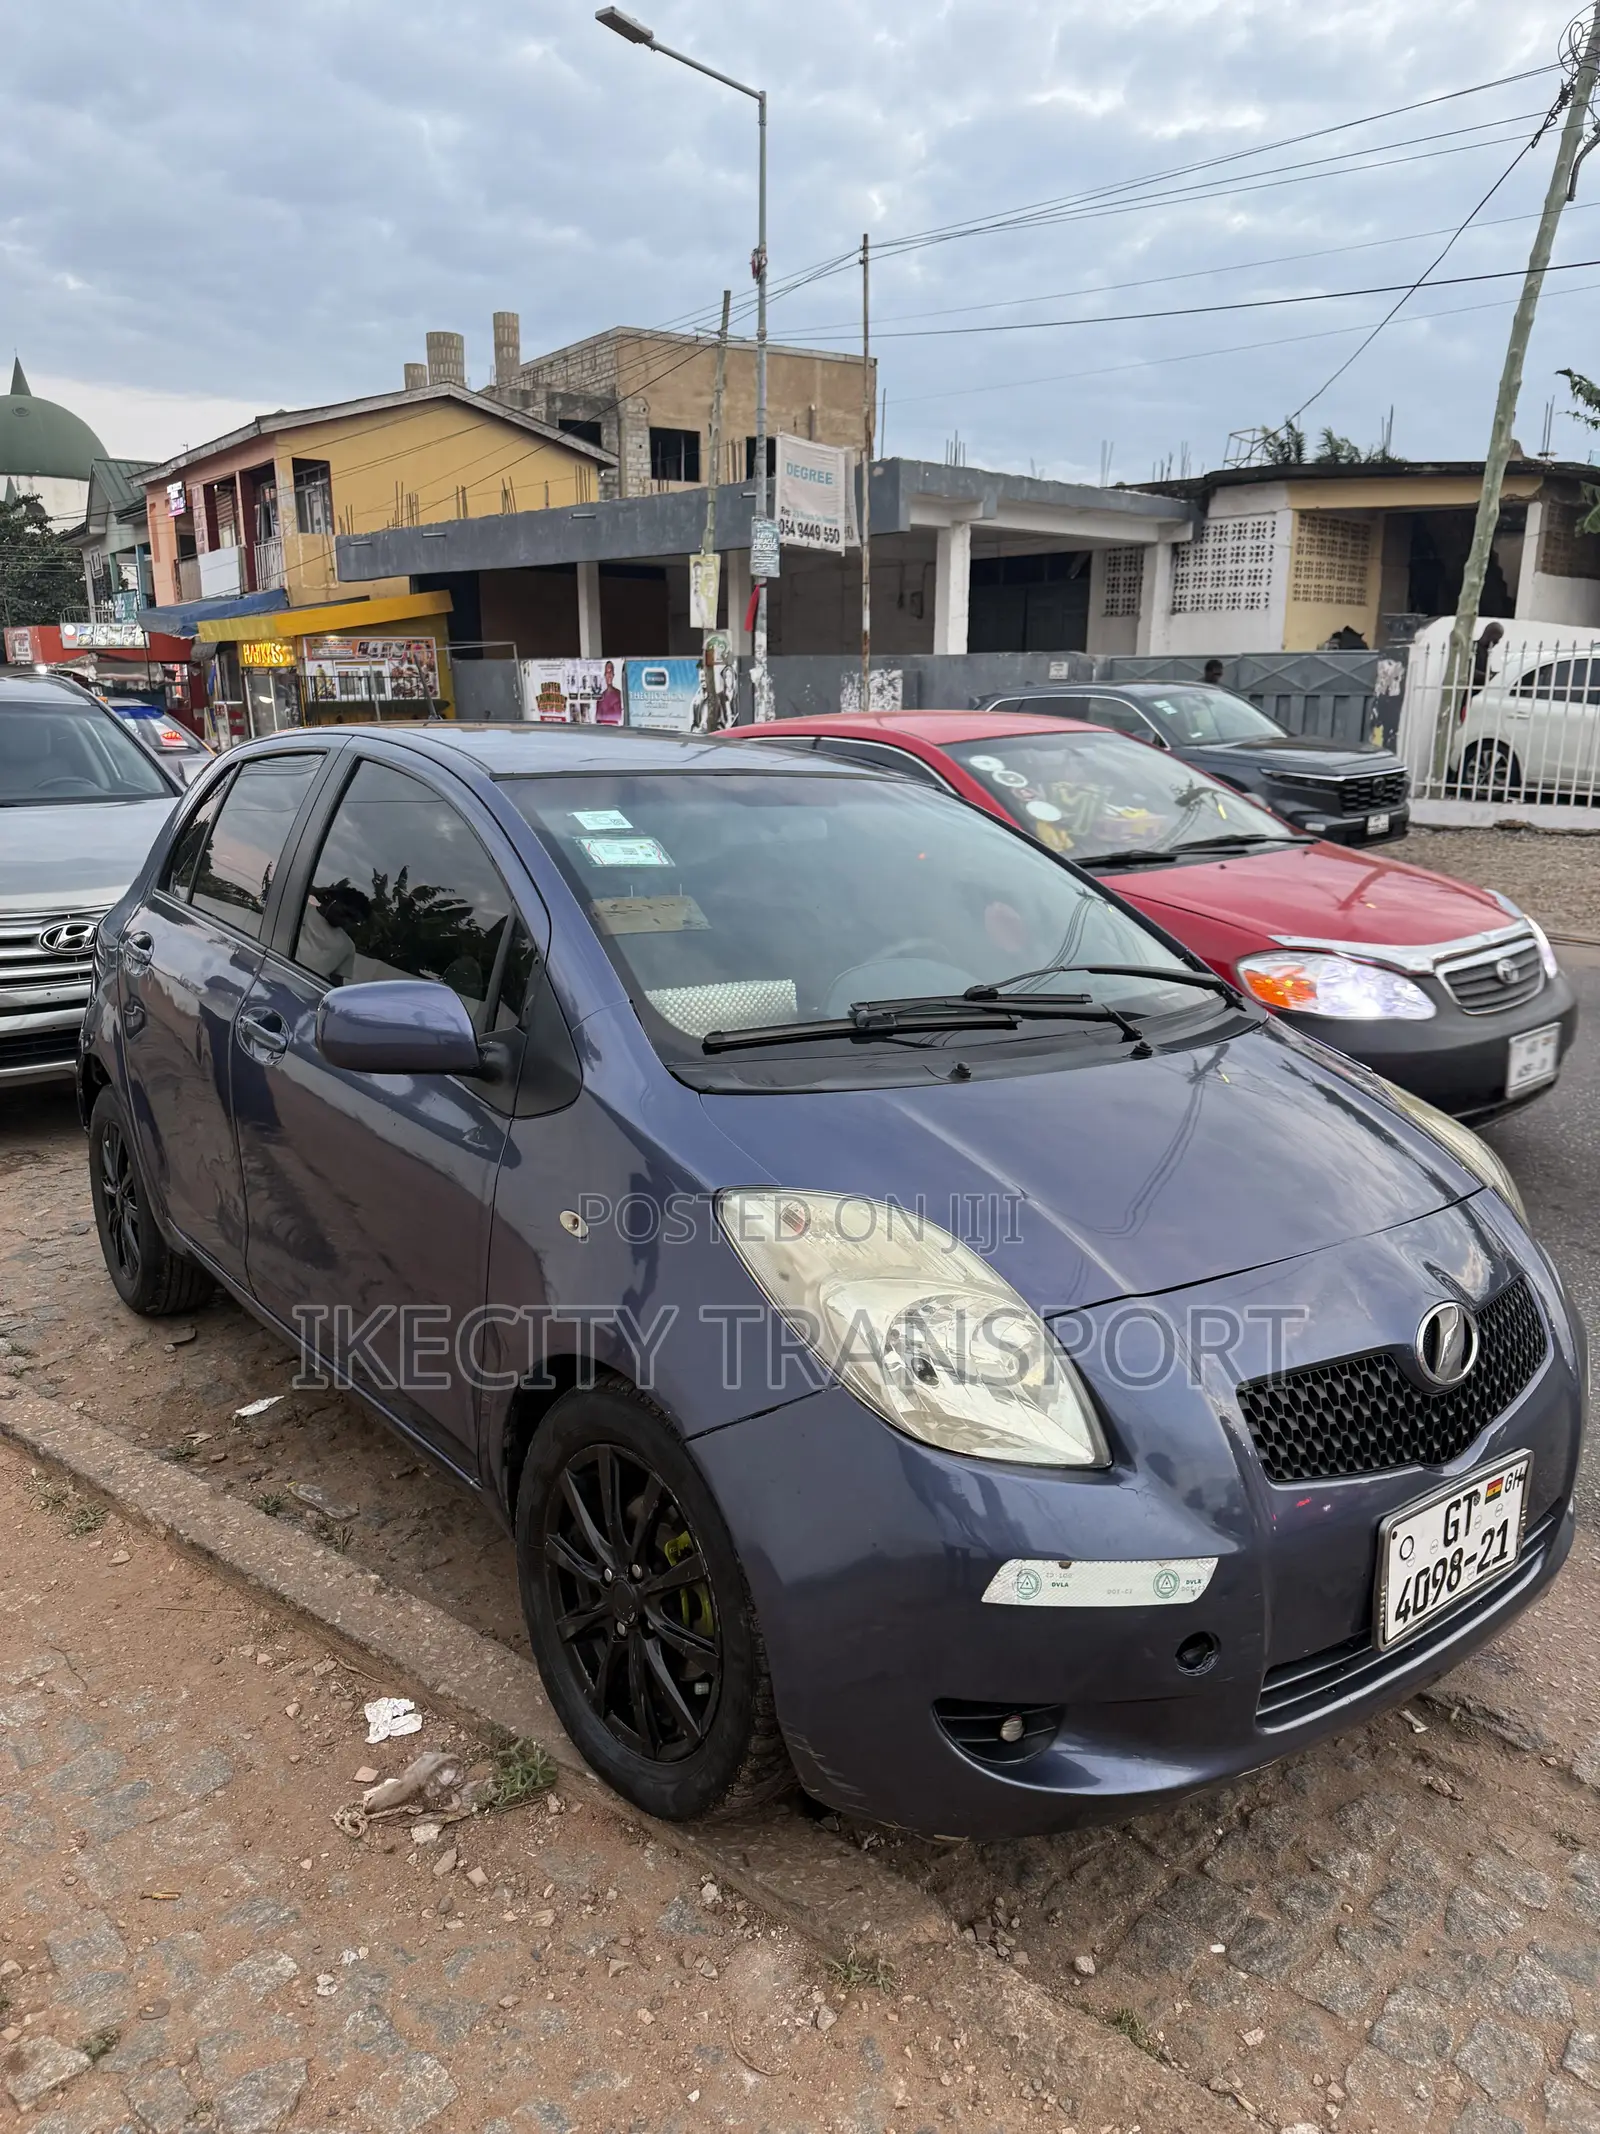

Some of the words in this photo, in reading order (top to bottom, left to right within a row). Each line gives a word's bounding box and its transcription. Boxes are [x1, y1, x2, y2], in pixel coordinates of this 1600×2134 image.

[786, 462, 834, 485] DEGREE
[779, 518, 796, 537] 054
[797, 522, 821, 541] 9449
[1505, 1467, 1524, 1493] GH
[1443, 1489, 1479, 1547] GT
[1395, 1518, 1509, 1624] 4098-21
